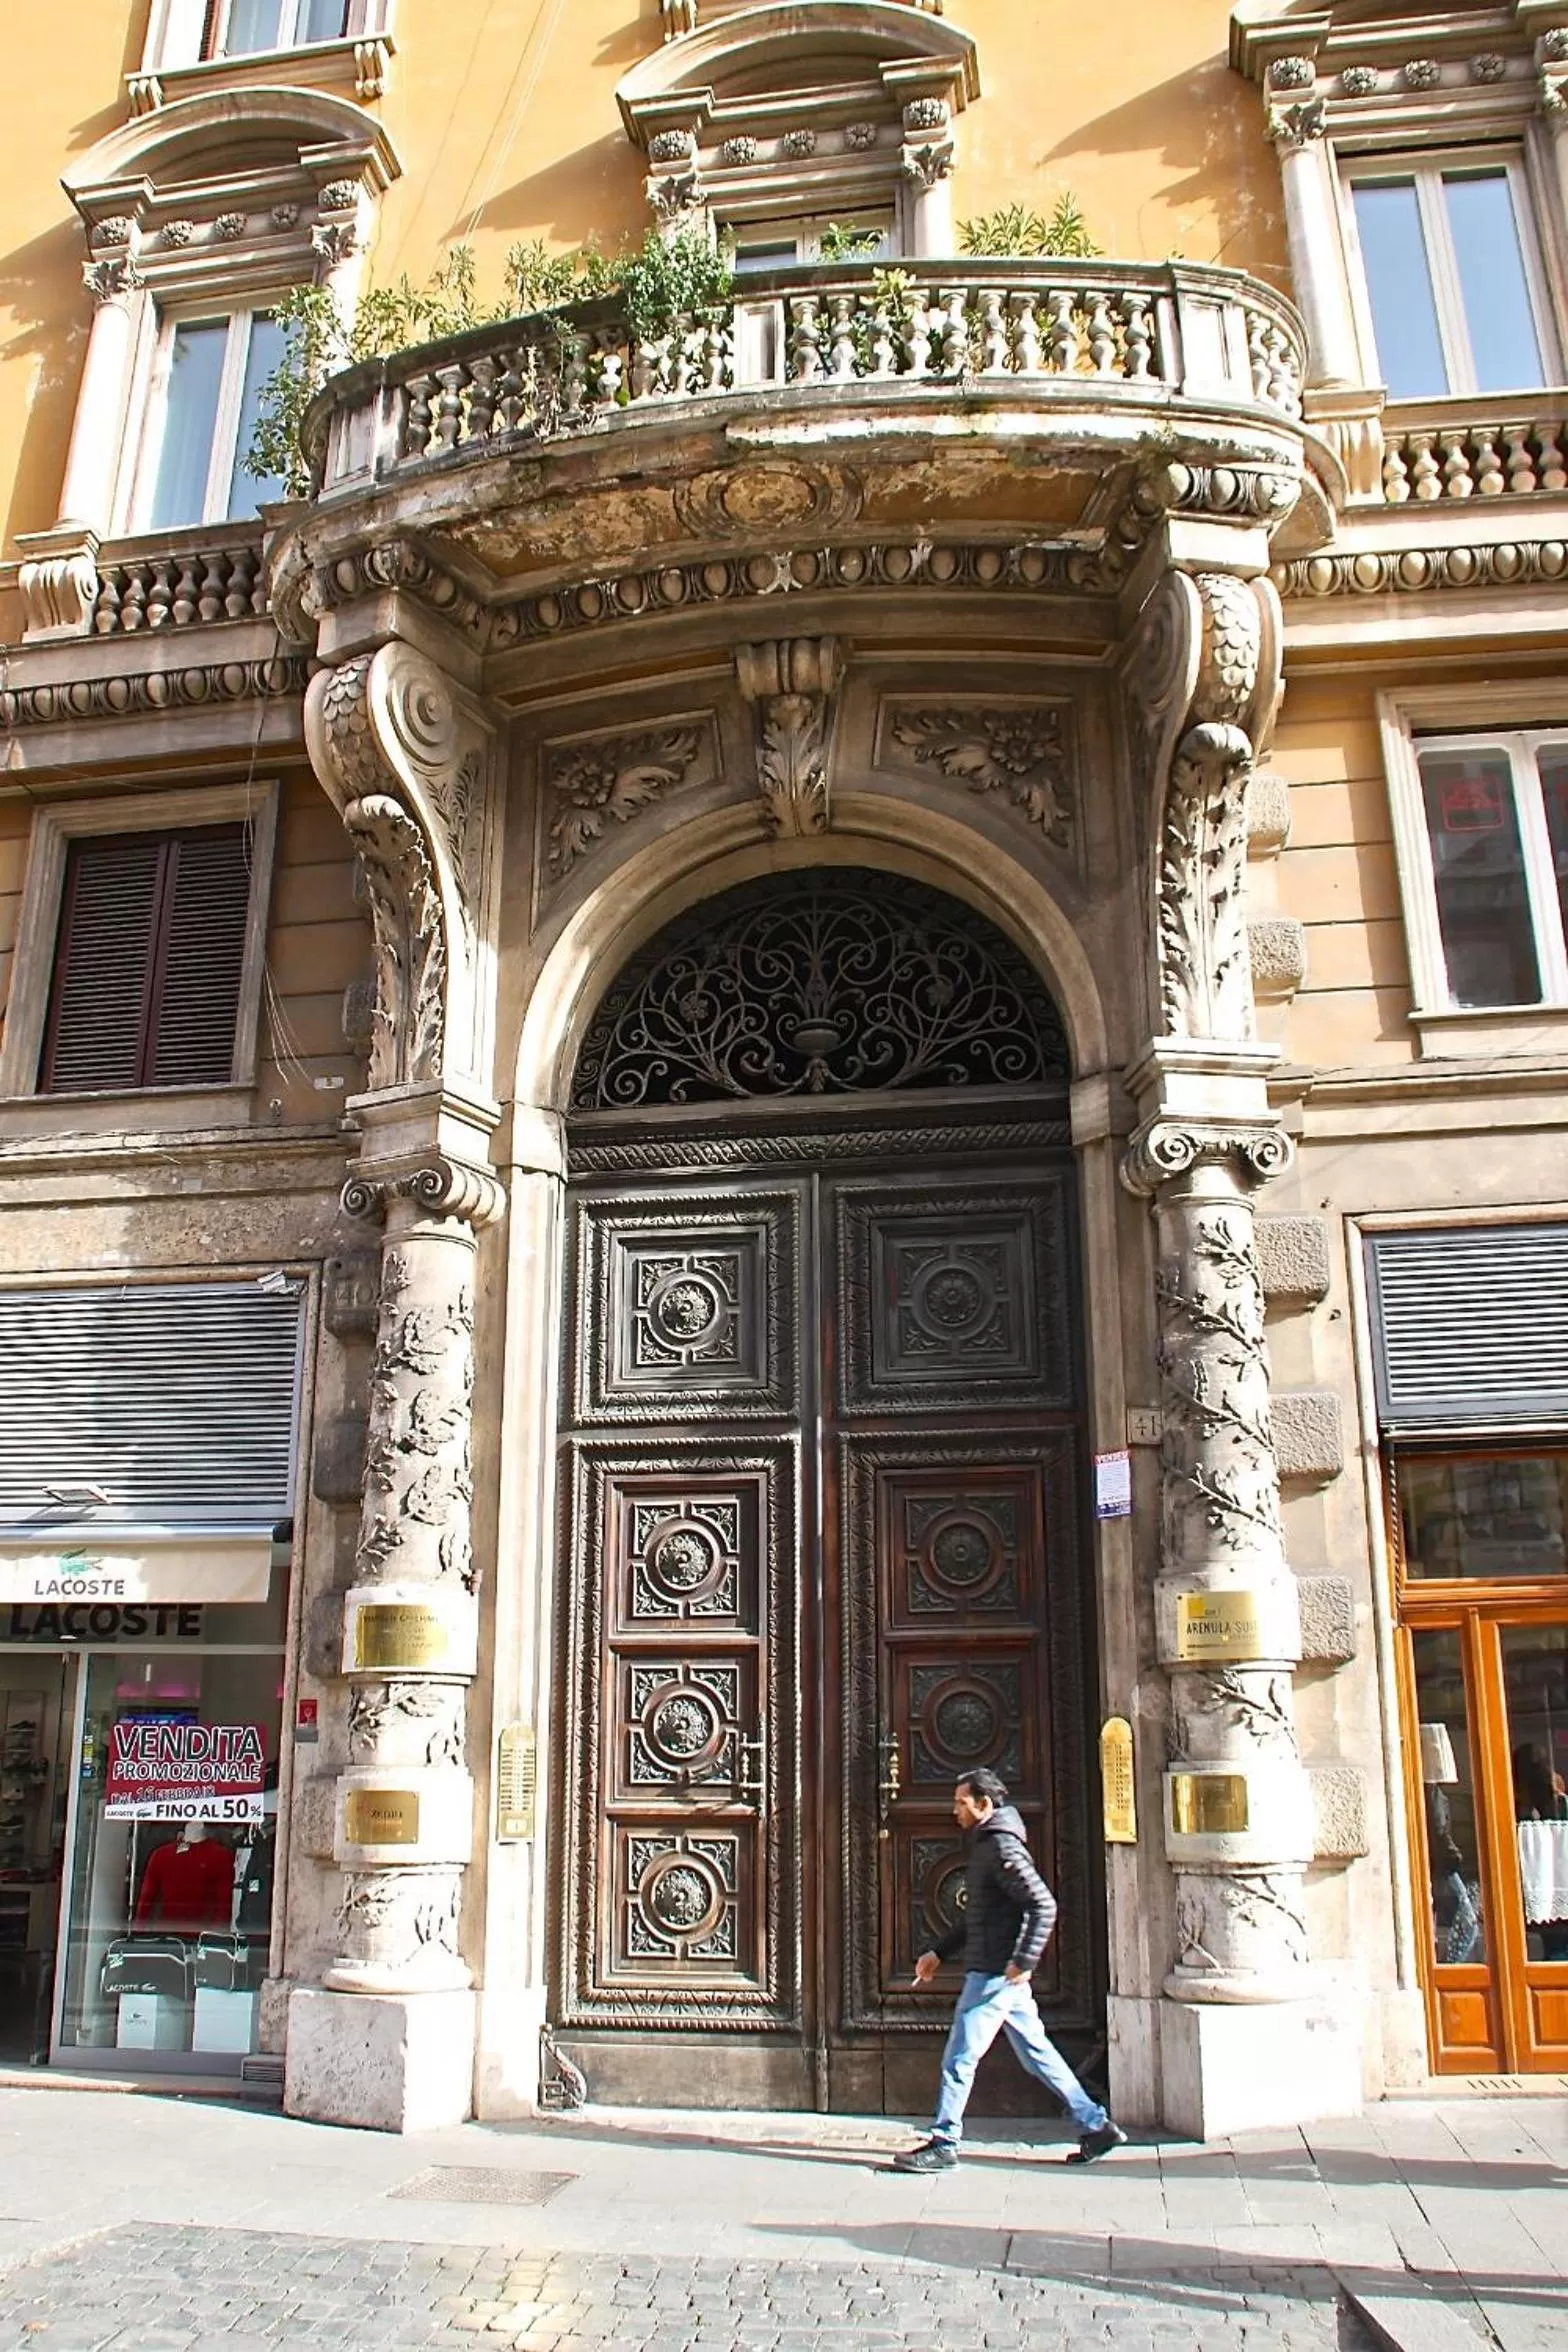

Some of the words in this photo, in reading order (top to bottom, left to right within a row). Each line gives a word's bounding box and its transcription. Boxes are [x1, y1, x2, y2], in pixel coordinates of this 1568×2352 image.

[34, 1580, 125, 1595] LACOSTE
[10, 1602, 203, 1636] LACOSTE
[114, 1725, 264, 1762] VENDITA
[112, 1761, 261, 1782] PROMOZIONALE
[156, 1804, 197, 1818] FINO
[199, 1803, 220, 1818] AL
[223, 1798, 249, 1818] 50
